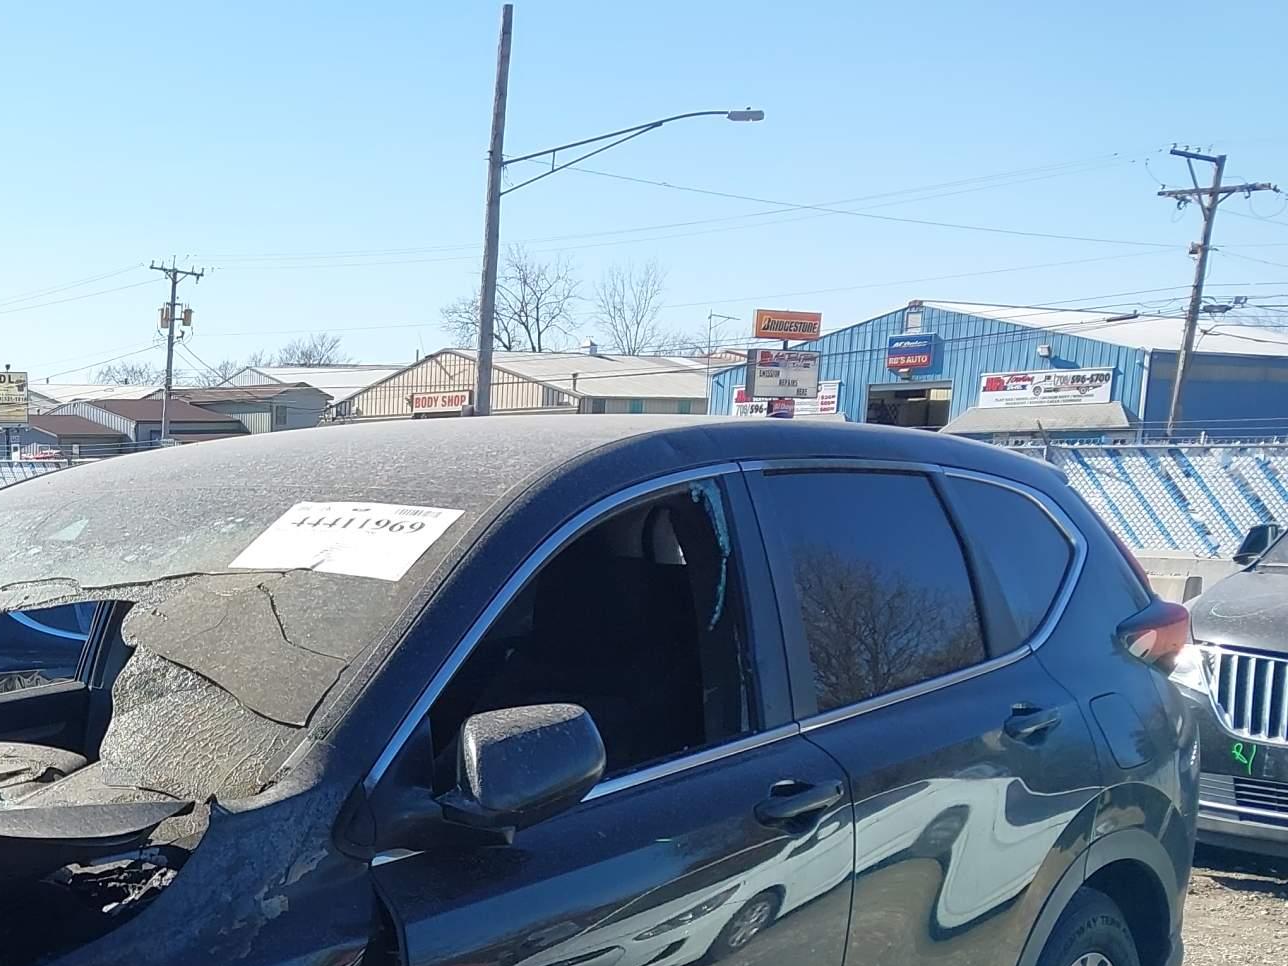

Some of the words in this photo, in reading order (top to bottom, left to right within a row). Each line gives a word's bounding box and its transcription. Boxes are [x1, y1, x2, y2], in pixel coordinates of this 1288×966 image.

[761, 317, 818, 333] BRIDGESTONE
[907, 355, 928, 363] AUTO
[778, 379, 798, 387] REPAIRS
[414, 396, 439, 408] BODY
[441, 394, 467, 407] SHOP
[291, 515, 427, 534] 44411969
